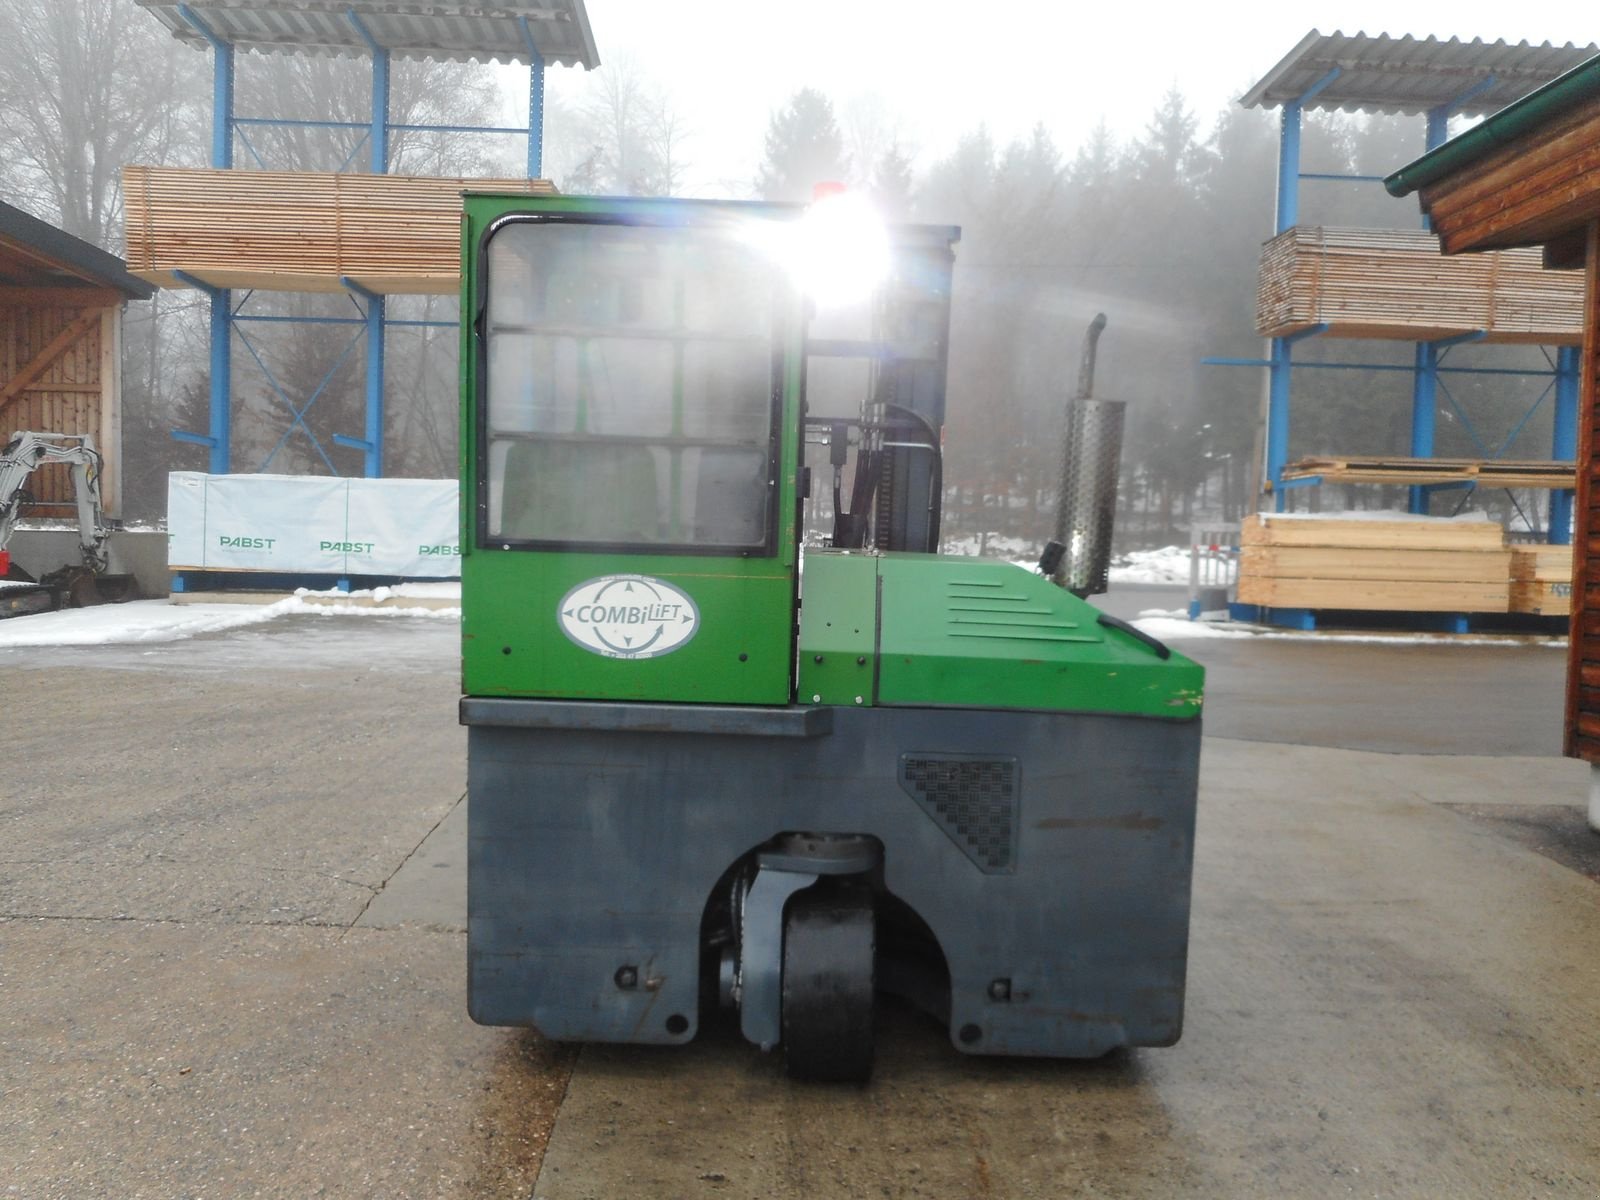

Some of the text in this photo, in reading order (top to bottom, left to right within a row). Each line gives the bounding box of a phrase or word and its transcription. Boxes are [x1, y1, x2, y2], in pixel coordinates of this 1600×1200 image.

[220, 536, 276, 549] PABST
[320, 541, 375, 553] PABST
[418, 545, 460, 556] PABS
